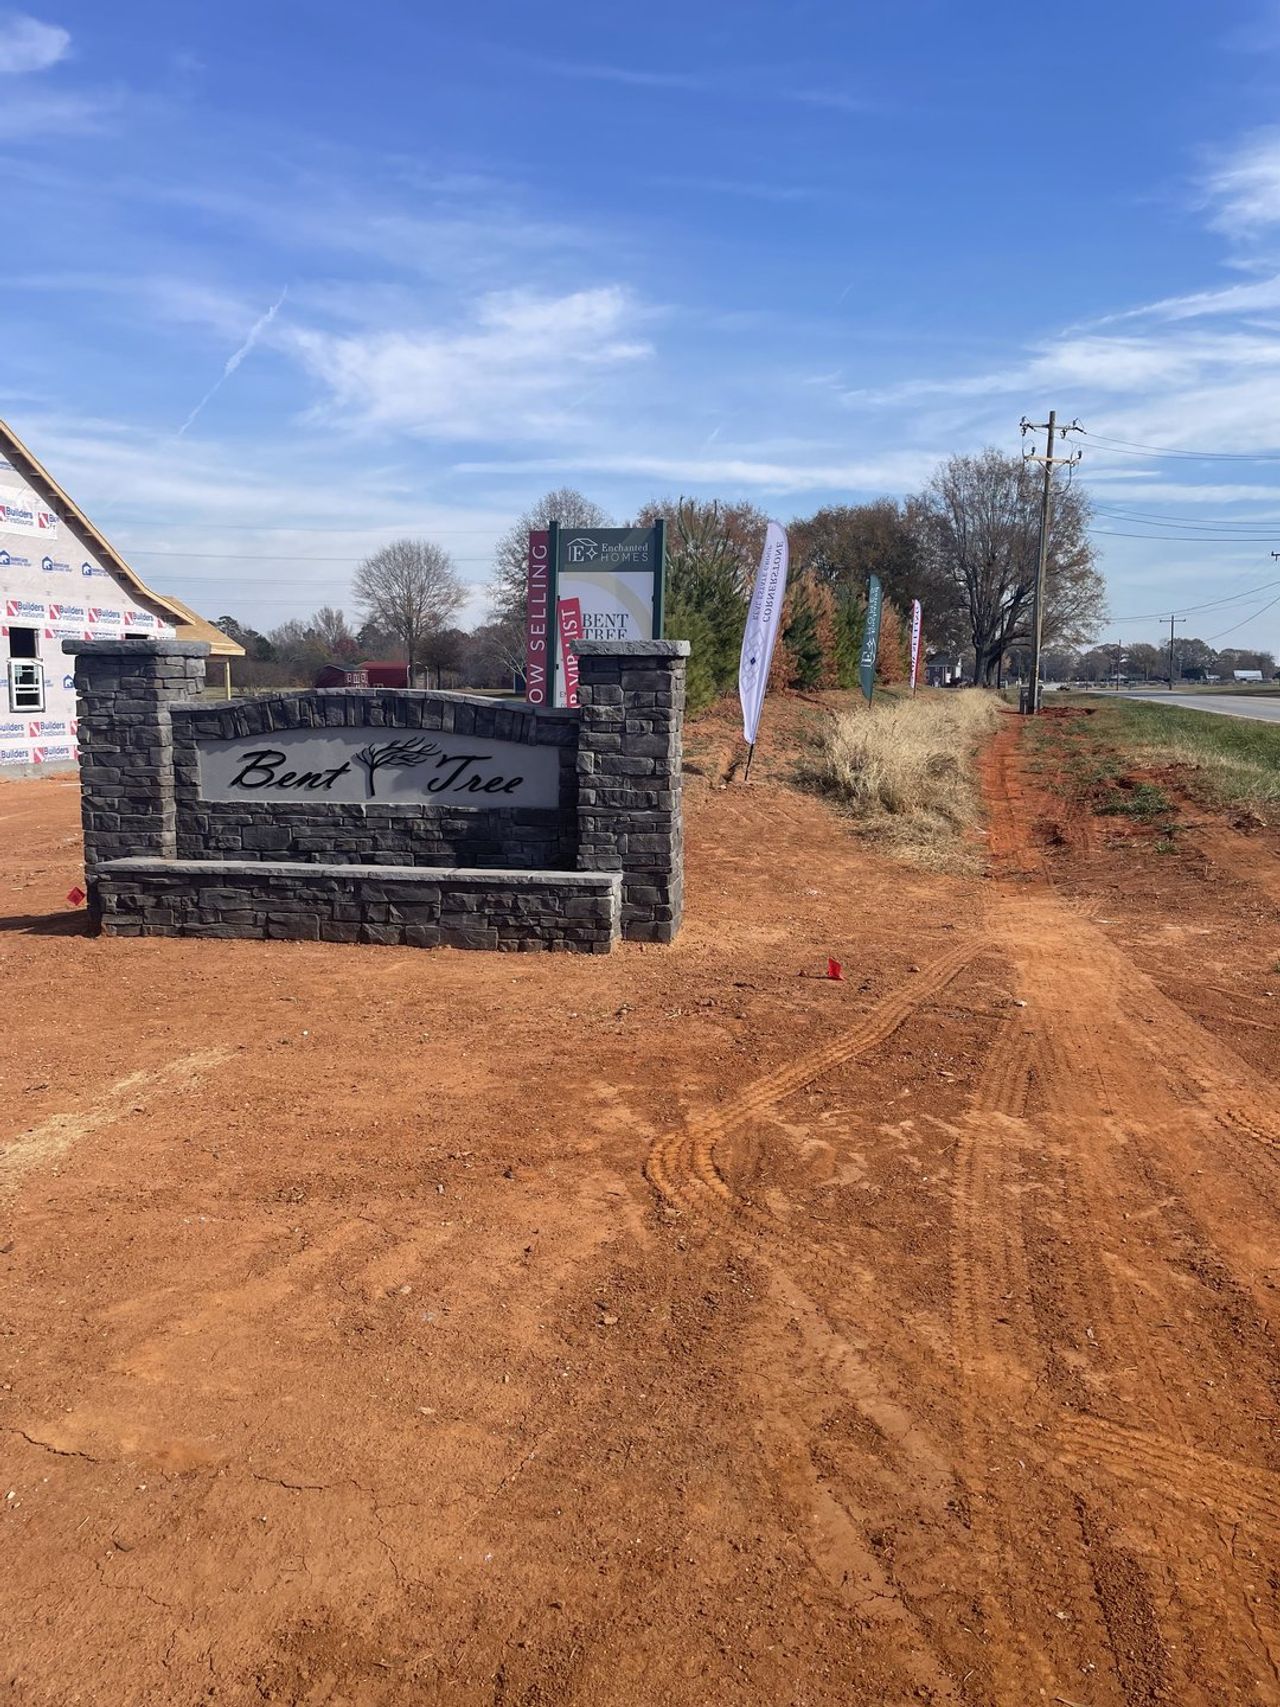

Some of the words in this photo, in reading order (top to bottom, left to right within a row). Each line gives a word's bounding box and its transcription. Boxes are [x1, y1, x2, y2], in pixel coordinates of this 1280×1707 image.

[6, 506, 33, 519] Builders
[602, 543, 648, 552] Enchanted
[600, 552, 649, 562] HOMES
[531, 545, 548, 651] SELLING
[17, 601, 45, 612] Builders
[59, 605, 84, 615] Builders
[97, 608, 120, 619] Builders
[133, 612, 154, 621] Builders
[583, 613, 629, 627] BENT
[561, 609, 578, 647] IST
[529, 663, 544, 703] OW
[40, 721, 65, 731] Builders
[1, 750, 29, 759] Builders
[44, 746, 69, 756] Builders
[231, 748, 351, 790] Bent
[428, 754, 524, 795] Tree
